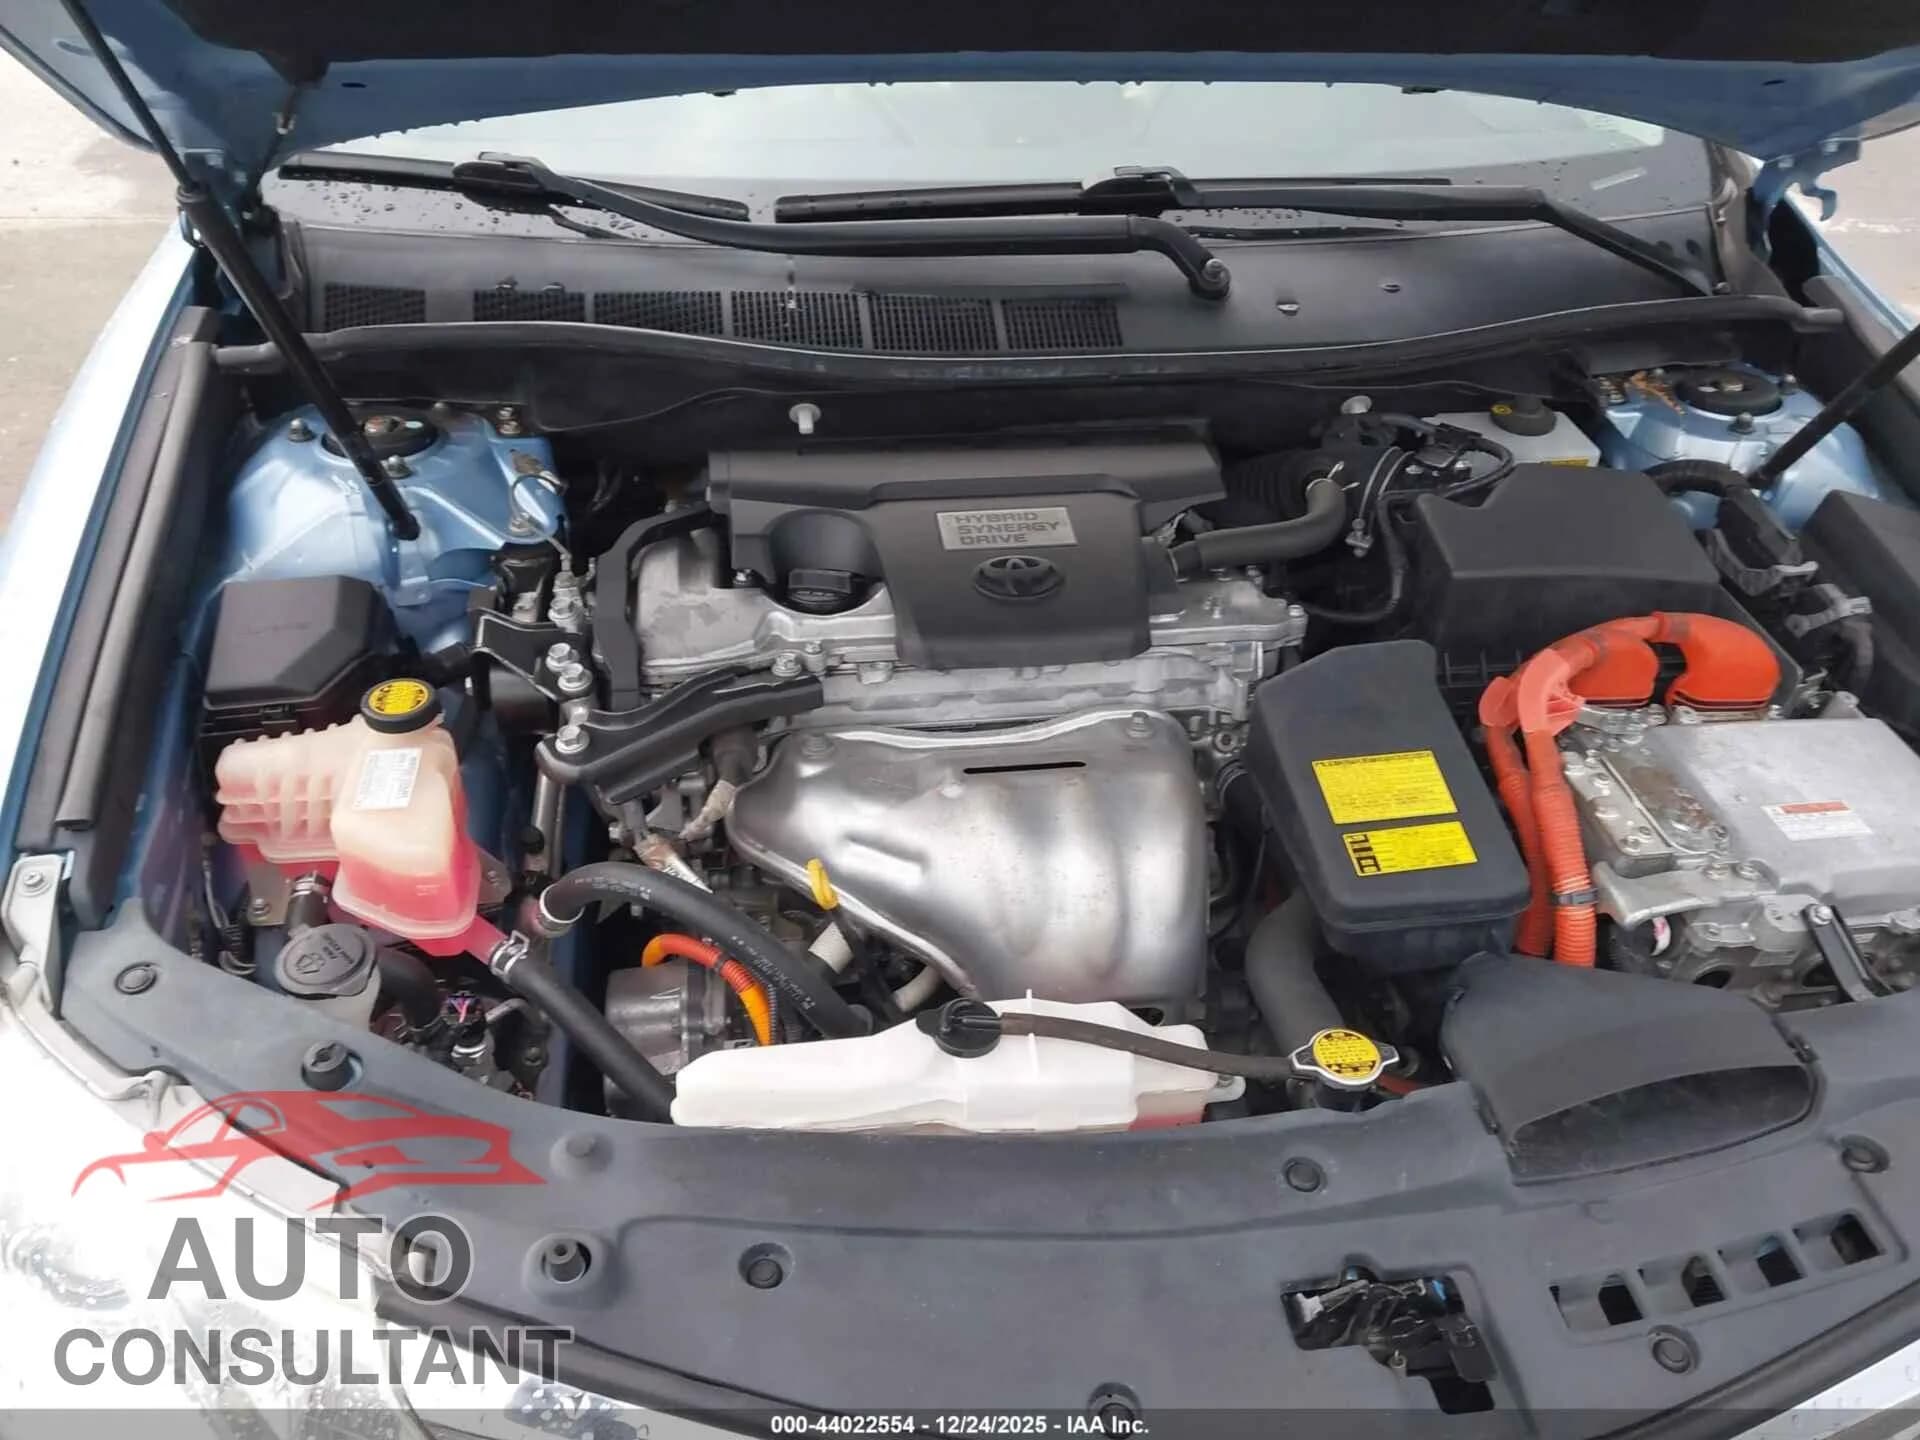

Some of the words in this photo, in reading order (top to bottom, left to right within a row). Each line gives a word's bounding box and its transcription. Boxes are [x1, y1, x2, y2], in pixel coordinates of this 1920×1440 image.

[955, 512, 1038, 524] HYBRID
[957, 521, 1060, 535] SYNERGY
[960, 534, 1028, 546] DRIVE
